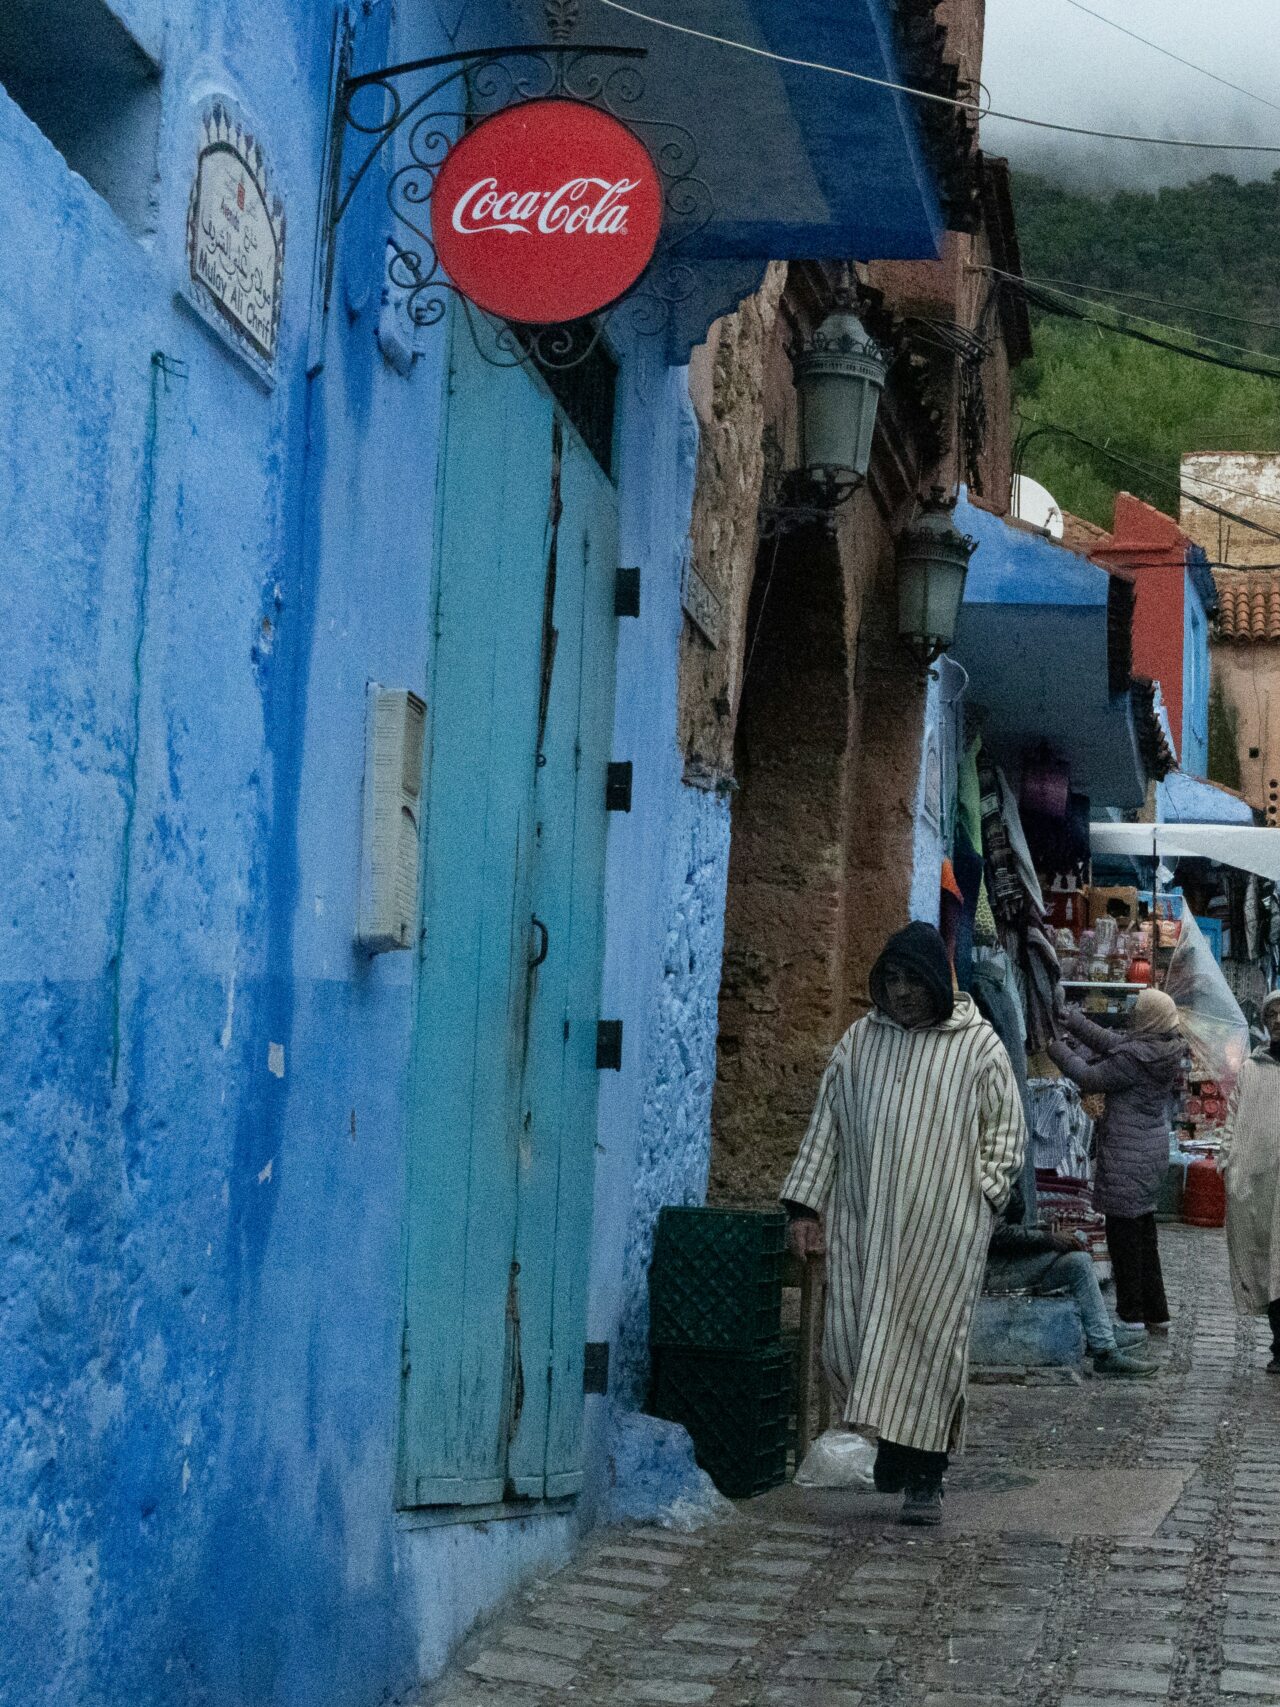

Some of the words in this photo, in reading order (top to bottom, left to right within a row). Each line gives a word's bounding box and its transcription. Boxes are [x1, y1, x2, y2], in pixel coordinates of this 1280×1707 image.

[452, 177, 642, 235] Coca-Cola
[199, 248, 227, 300] Mulay
[230, 286, 243, 315] Ali
[246, 302, 270, 346] Chrif
